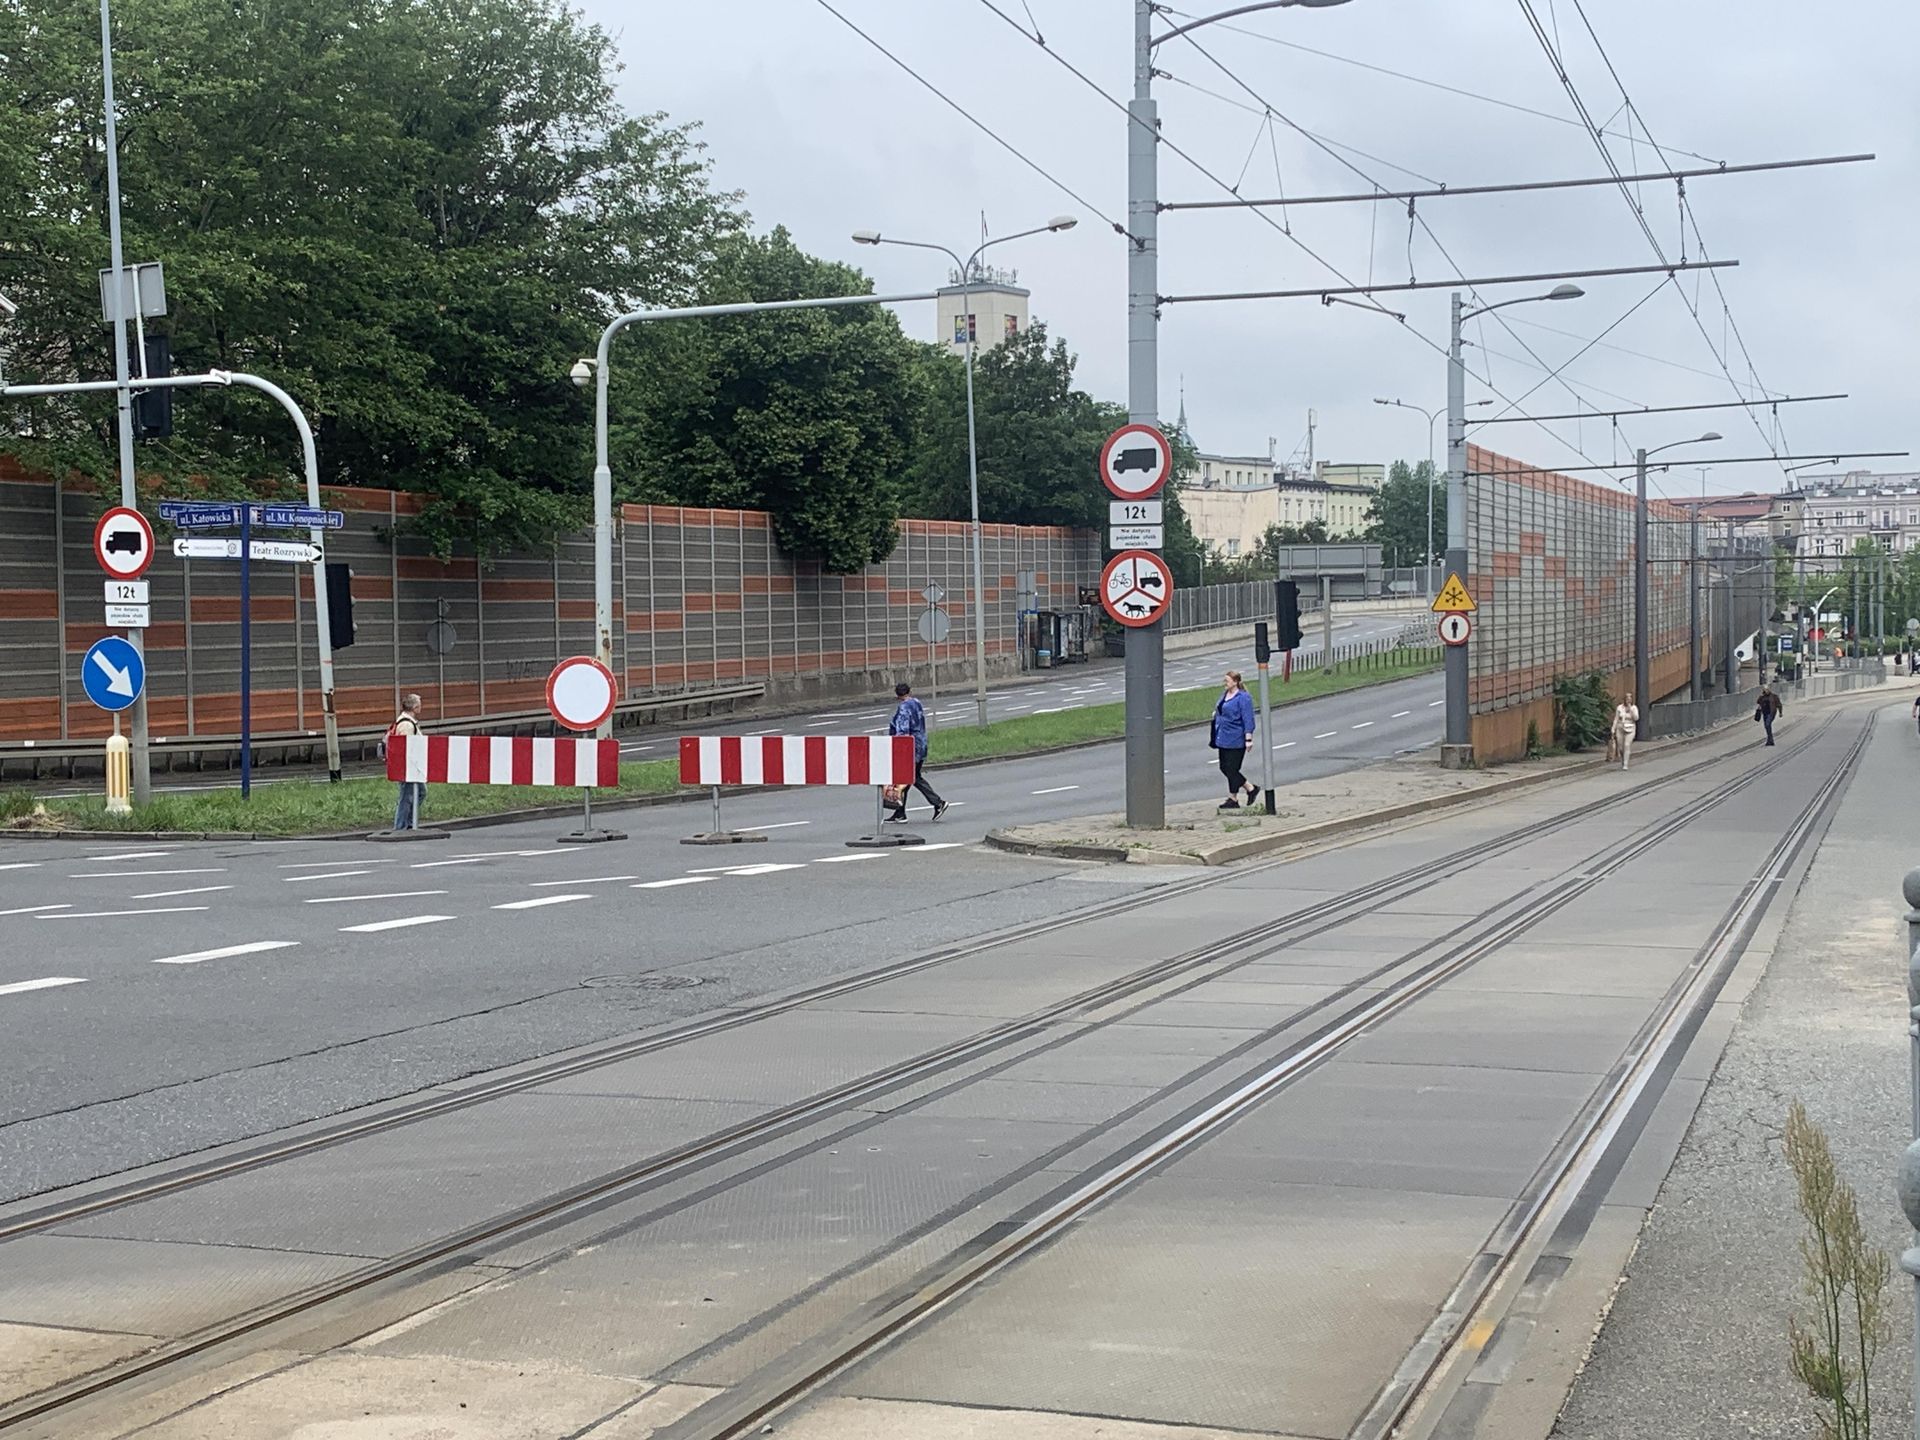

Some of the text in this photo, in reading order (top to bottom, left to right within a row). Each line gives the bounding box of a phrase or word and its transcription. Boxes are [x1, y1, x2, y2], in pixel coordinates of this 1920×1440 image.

[180, 515, 190, 524] ul.
[192, 512, 232, 524] Katowicka
[1124, 506, 1146, 519] 12t
[266, 512, 338, 526] ul. M. Konopnickiej
[252, 546, 312, 558] Teatr Rozrywki
[117, 586, 136, 598] 12t
